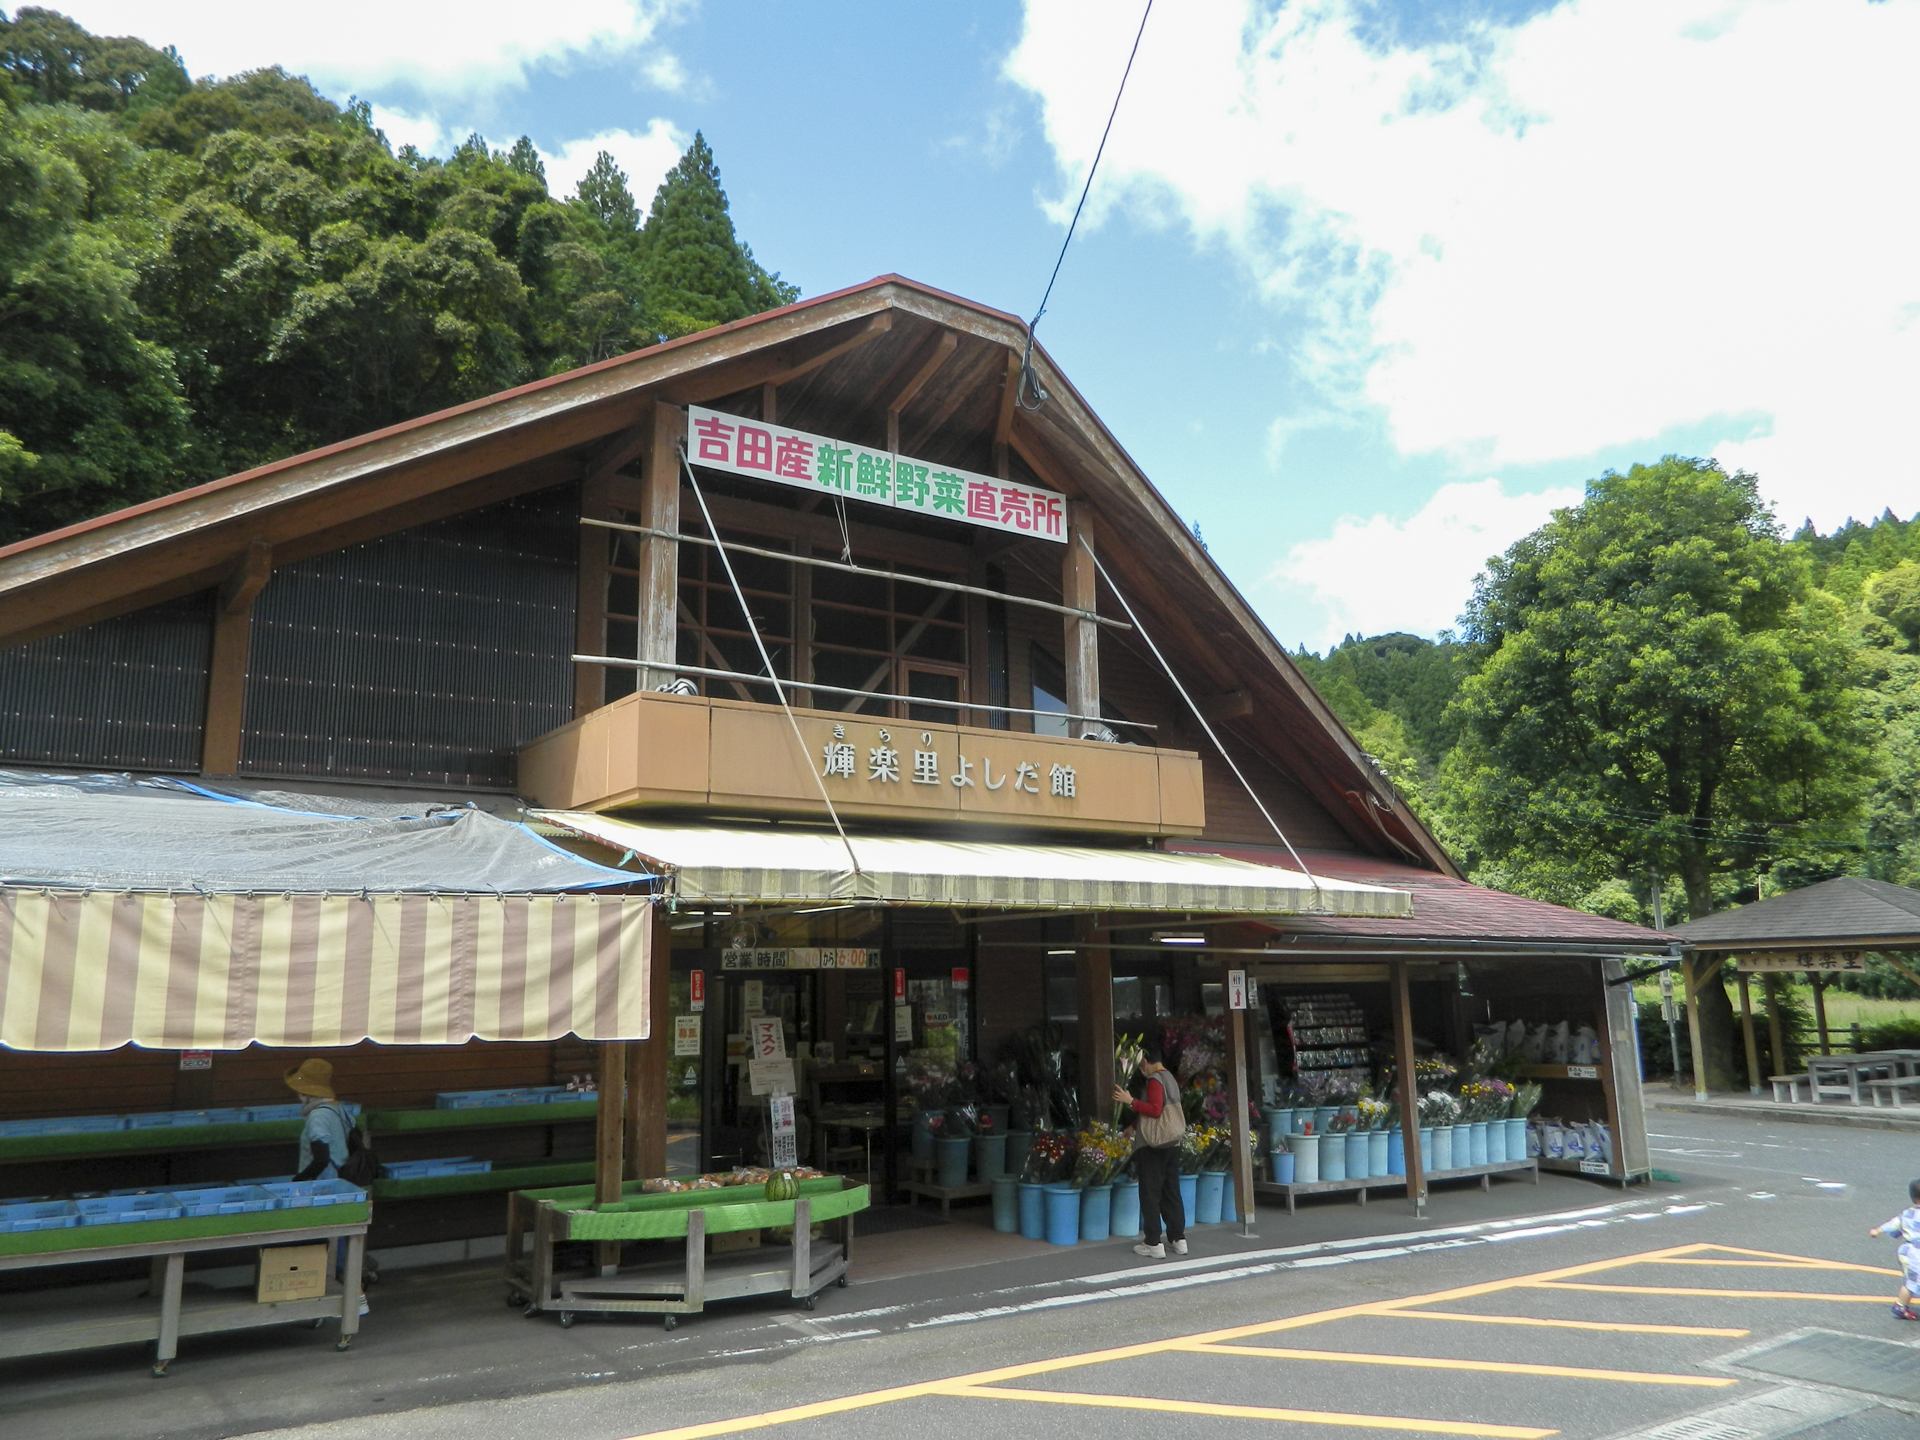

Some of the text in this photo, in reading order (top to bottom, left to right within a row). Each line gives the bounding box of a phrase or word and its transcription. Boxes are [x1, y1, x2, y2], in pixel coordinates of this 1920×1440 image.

[694, 416, 1062, 537] 吉田産新鮮野菜直売所
[833, 724, 933, 748] きらり
[822, 741, 1076, 798] 輝楽里よしだ館
[1796, 951, 1862, 969] 輝楽里
[933, 1013, 948, 1021] AED
[759, 1023, 775, 1056] マスク
